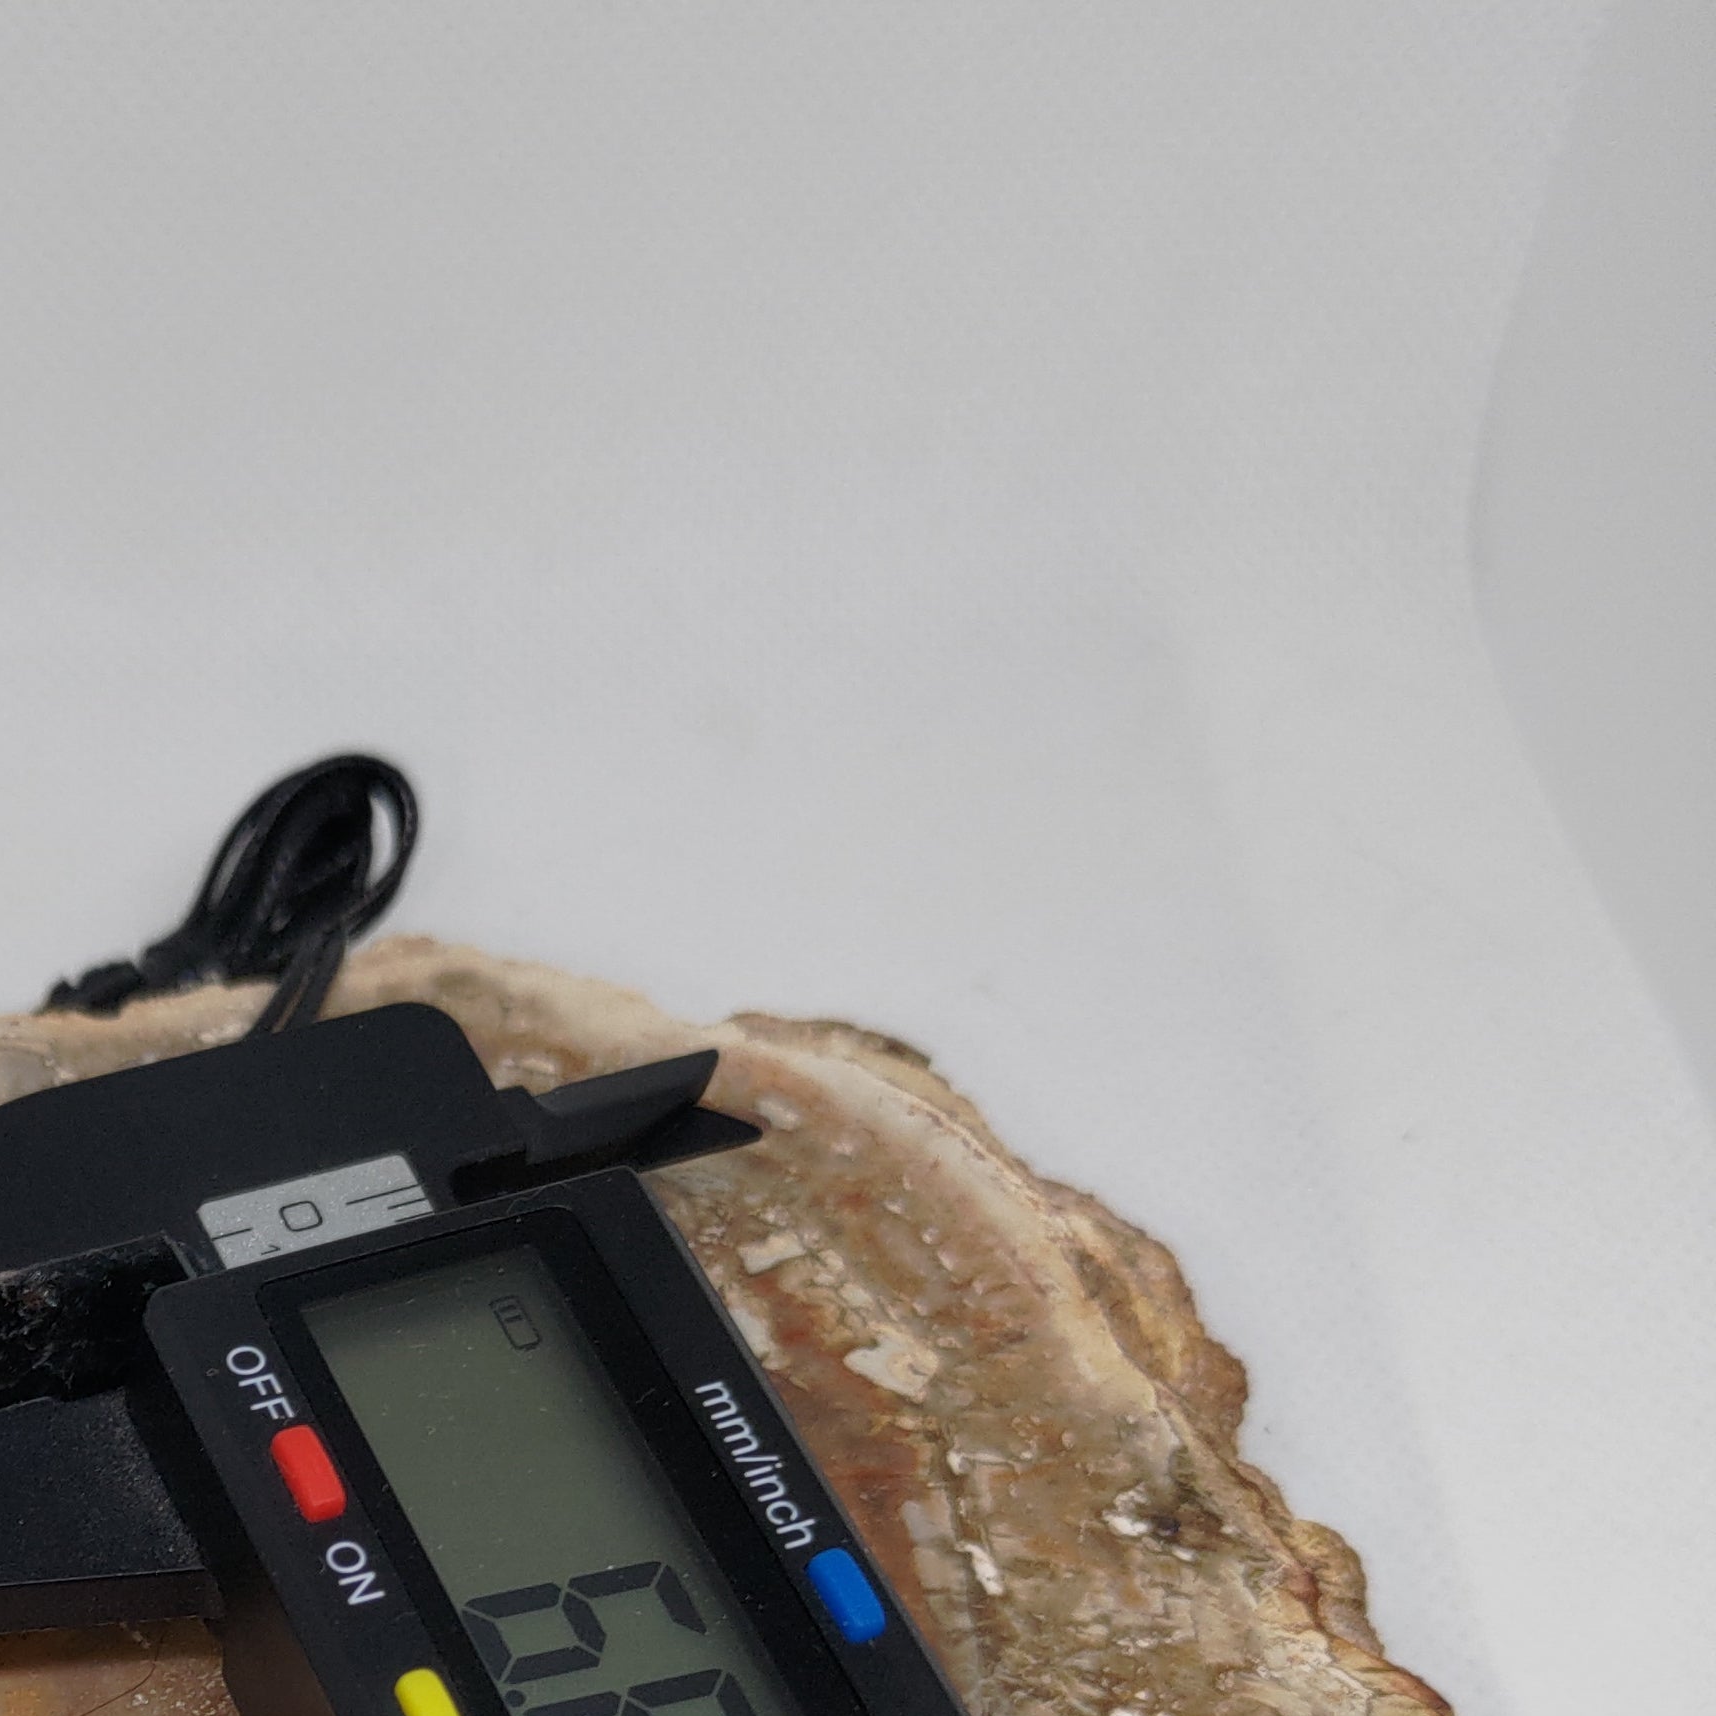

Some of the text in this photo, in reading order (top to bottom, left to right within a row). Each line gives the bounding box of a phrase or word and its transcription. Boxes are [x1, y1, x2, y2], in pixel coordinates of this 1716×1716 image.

[225, 1345, 295, 1420] OFF
[695, 1380, 815, 1550] mm/inch
[325, 1541, 385, 1605] ON
